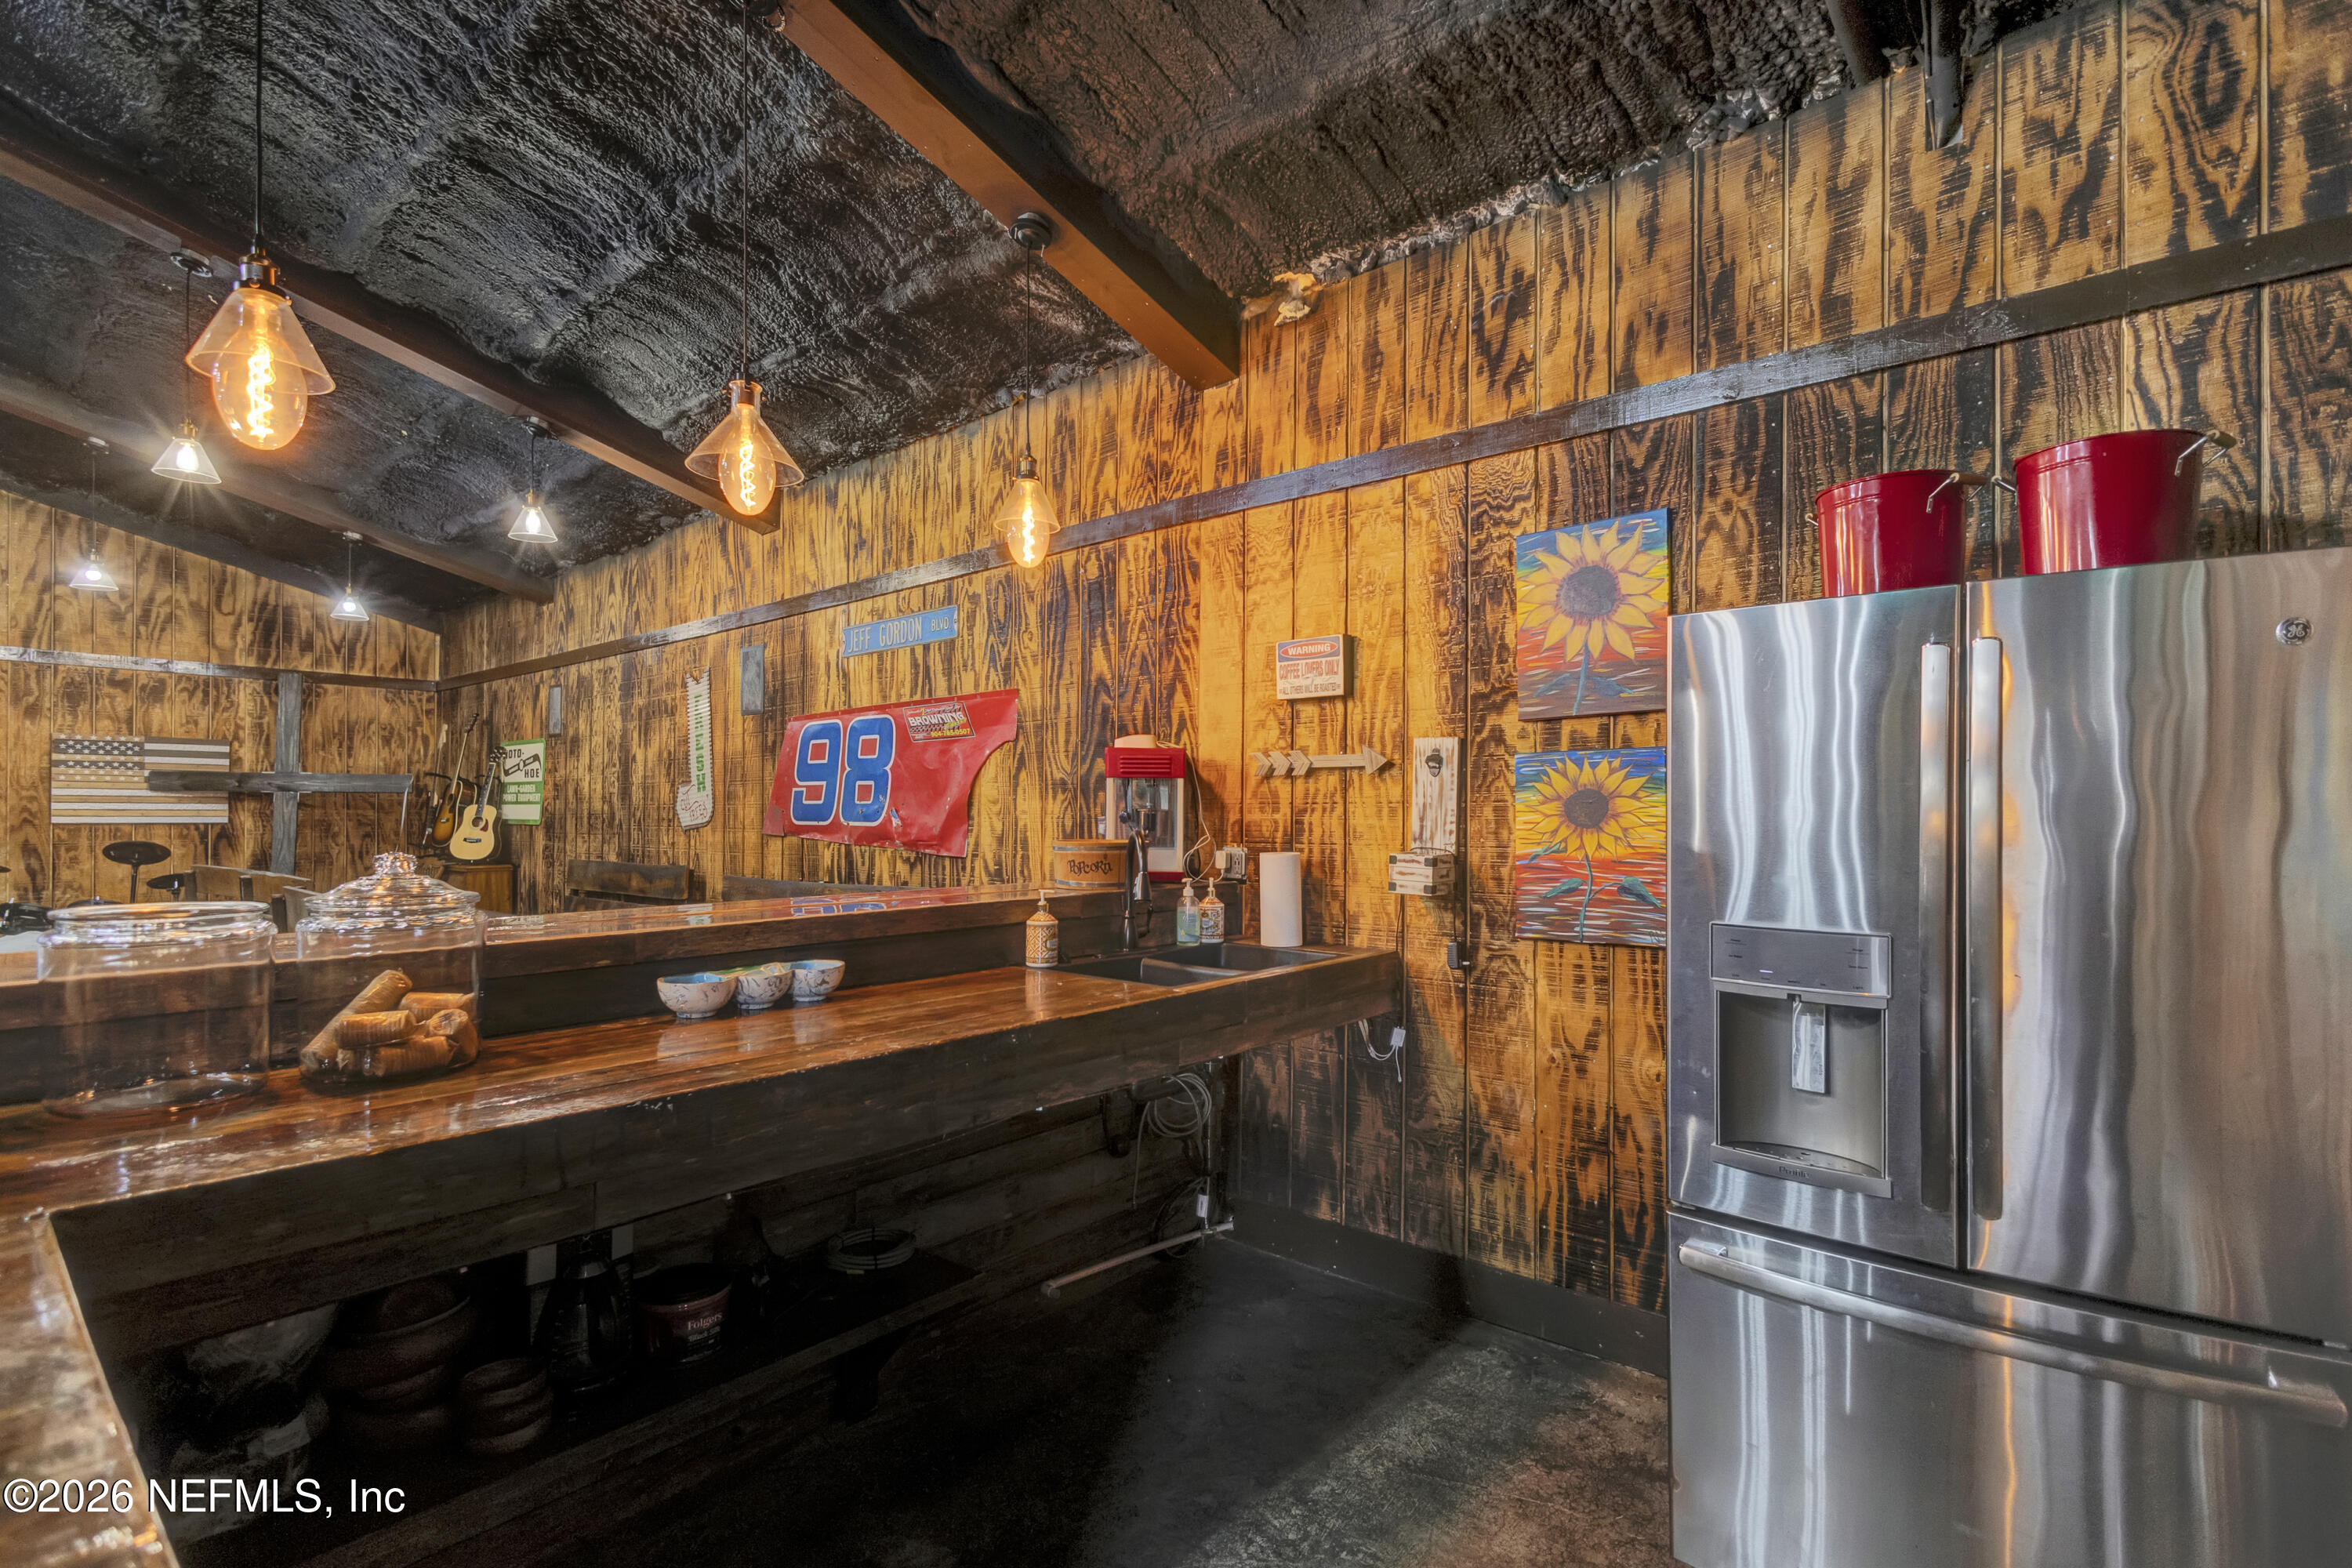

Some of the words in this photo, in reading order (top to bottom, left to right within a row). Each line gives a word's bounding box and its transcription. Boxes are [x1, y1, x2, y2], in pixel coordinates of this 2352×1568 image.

[848, 626, 871, 653] JEFF
[879, 616, 923, 648] GORDON
[931, 616, 951, 632] BLVD.
[1287, 643, 1330, 656] WARNING
[1279, 662, 1301, 681] COFFEE
[1301, 660, 1323, 677] LOVERS
[1325, 658, 1340, 676] ONLY
[1290, 684, 1304, 695] OTHERS
[1314, 684, 1319, 693] BE
[1319, 682, 1337, 691] ROASTED
[908, 711, 965, 727] BROWNING
[524, 768, 539, 778] HOE
[791, 714, 895, 826] 98
[506, 784, 536, 793] LAWN-GARDEN
[503, 793, 517, 802] POWER
[517, 793, 540, 802] EQUIPMENT
[1779, 1166, 1809, 1178] Profile
[688, 1312, 723, 1330] Folgers
